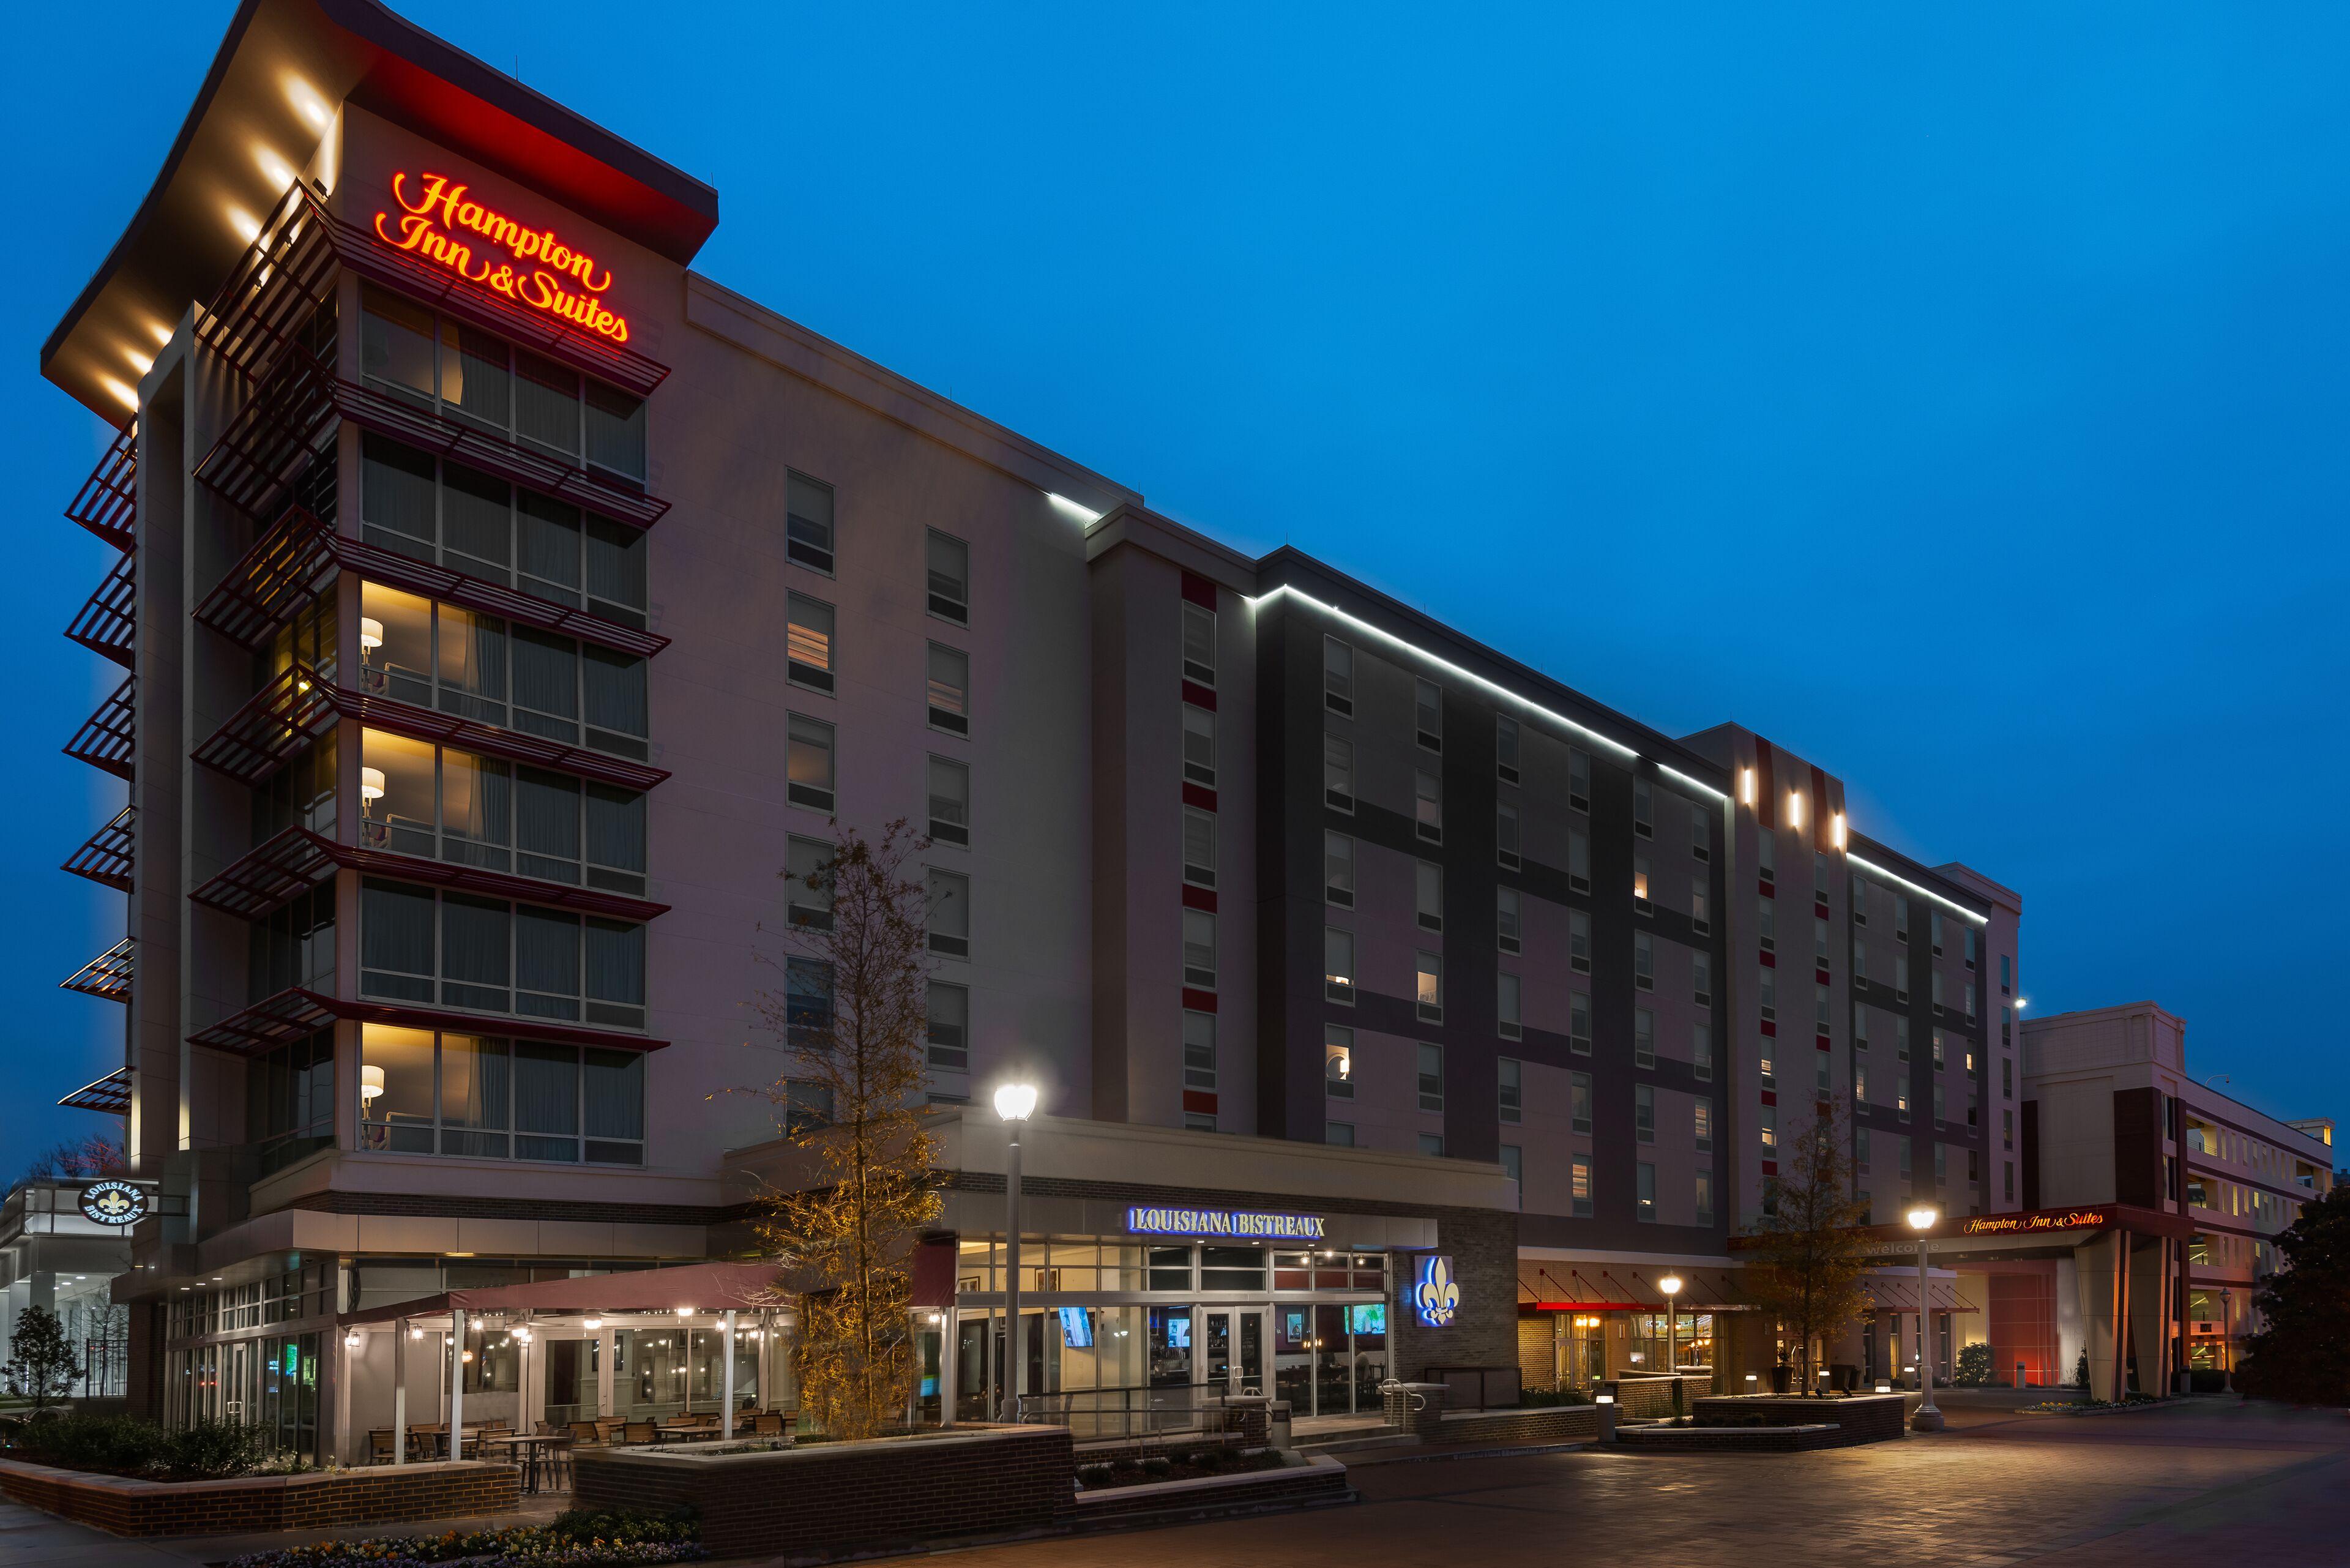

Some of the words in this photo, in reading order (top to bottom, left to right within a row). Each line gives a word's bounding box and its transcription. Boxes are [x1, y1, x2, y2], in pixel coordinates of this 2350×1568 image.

[392, 173, 611, 292] Hampton
[375, 212, 490, 282] Inn
[490, 266, 517, 299] &
[518, 271, 629, 342] Suites
[84, 1182, 143, 1201] LOUISIANA
[84, 1204, 144, 1223] BISTREAUX
[1136, 1209, 1232, 1233] LOUISIANA
[1238, 1214, 1325, 1236] BISTREAUX
[1964, 1218, 2022, 1234] Hampton
[2023, 1215, 2056, 1229] Inn
[2056, 1218, 2065, 1227] &
[2064, 1212, 2103, 1225] Suites
